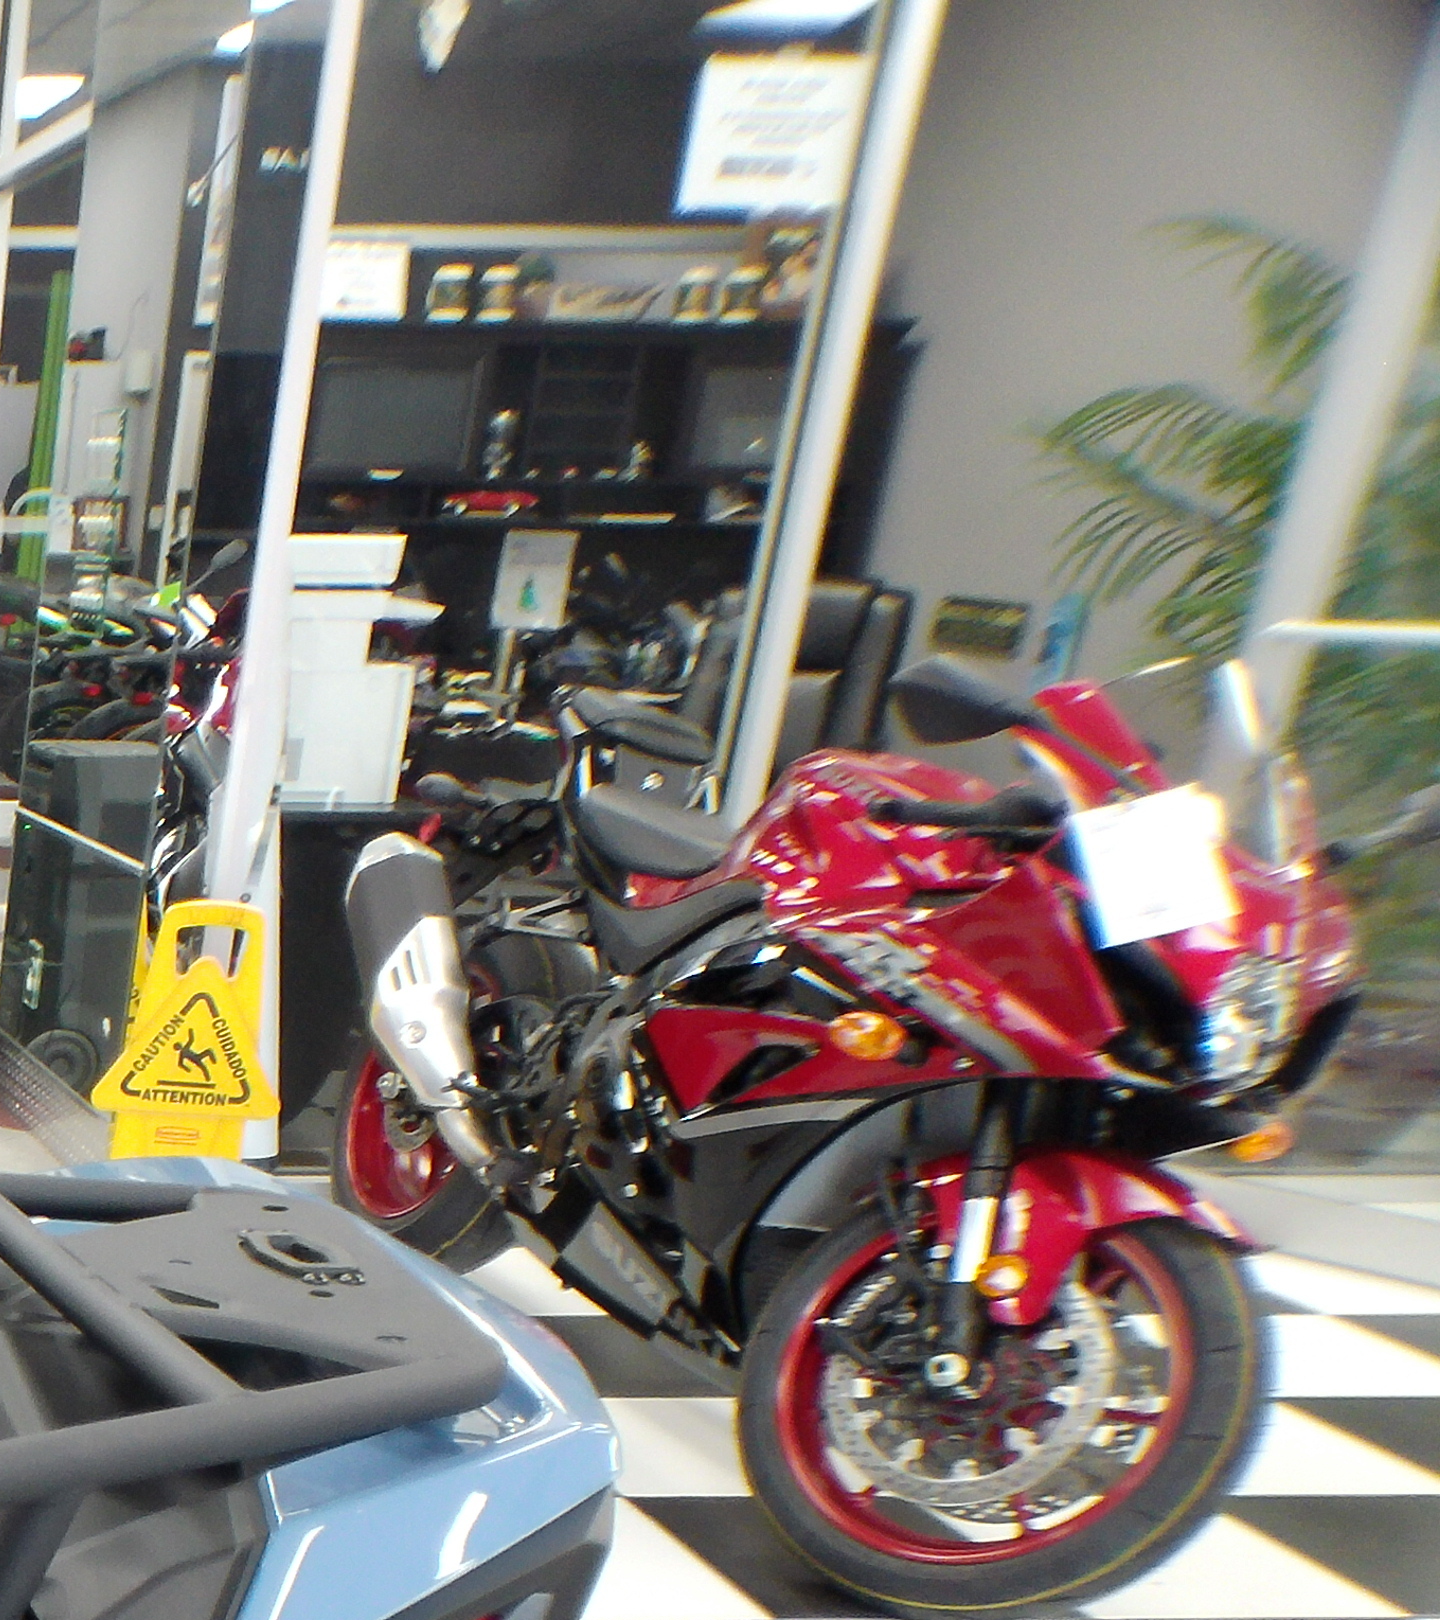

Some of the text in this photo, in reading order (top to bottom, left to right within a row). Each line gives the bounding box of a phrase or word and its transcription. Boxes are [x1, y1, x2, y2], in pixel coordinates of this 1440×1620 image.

[133, 1014, 185, 1072] CAUTION
[212, 1019, 246, 1079] CUIDADO
[142, 1089, 226, 1106] ATTENTION
